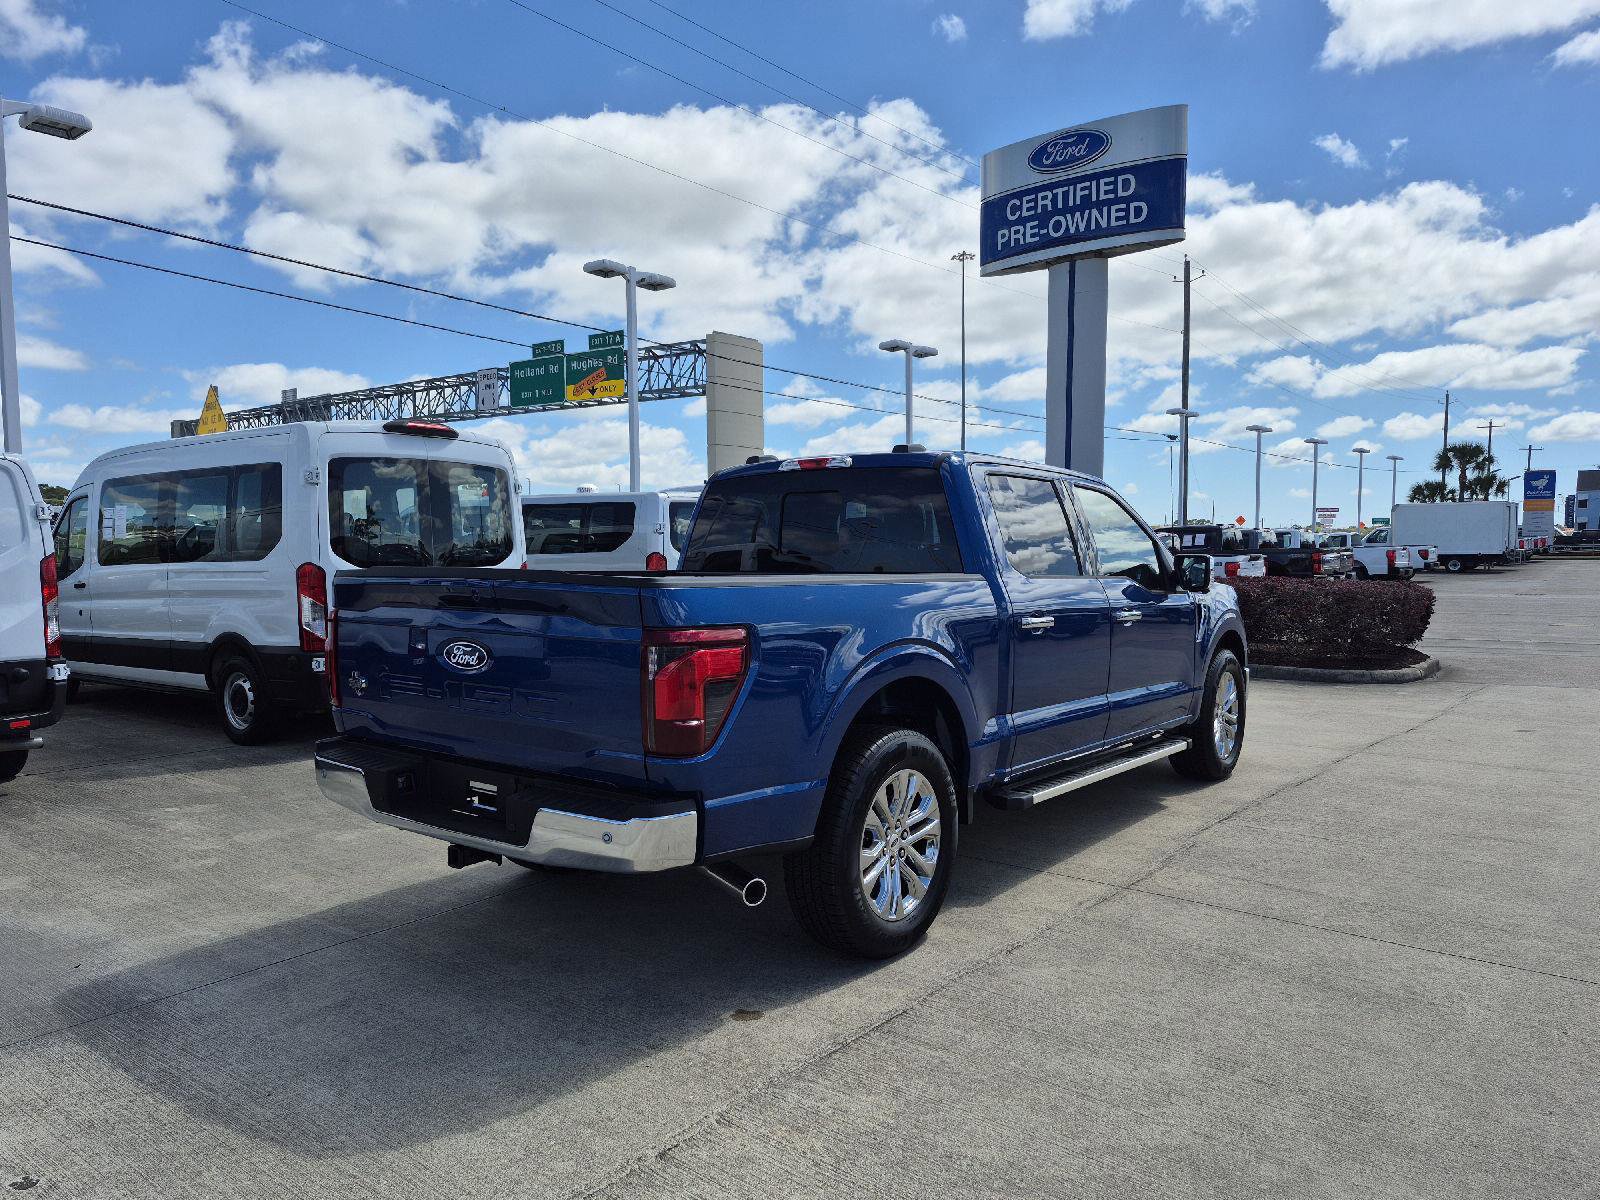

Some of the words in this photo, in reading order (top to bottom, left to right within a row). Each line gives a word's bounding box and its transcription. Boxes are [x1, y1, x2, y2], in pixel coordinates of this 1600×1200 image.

[1042, 135, 1089, 165] Ford
[1006, 173, 1136, 221] CERTIFIED
[997, 201, 1148, 251] PRE-OWNED
[591, 337, 603, 346] EXIT
[615, 334, 621, 343] A
[514, 365, 545, 378] Holland
[549, 363, 559, 374] Rd
[571, 358, 604, 371] Hughes
[607, 354, 618, 365] Rd
[479, 372, 497, 382] SPEED
[599, 384, 617, 393] ONLY
[450, 645, 479, 666] Ford
